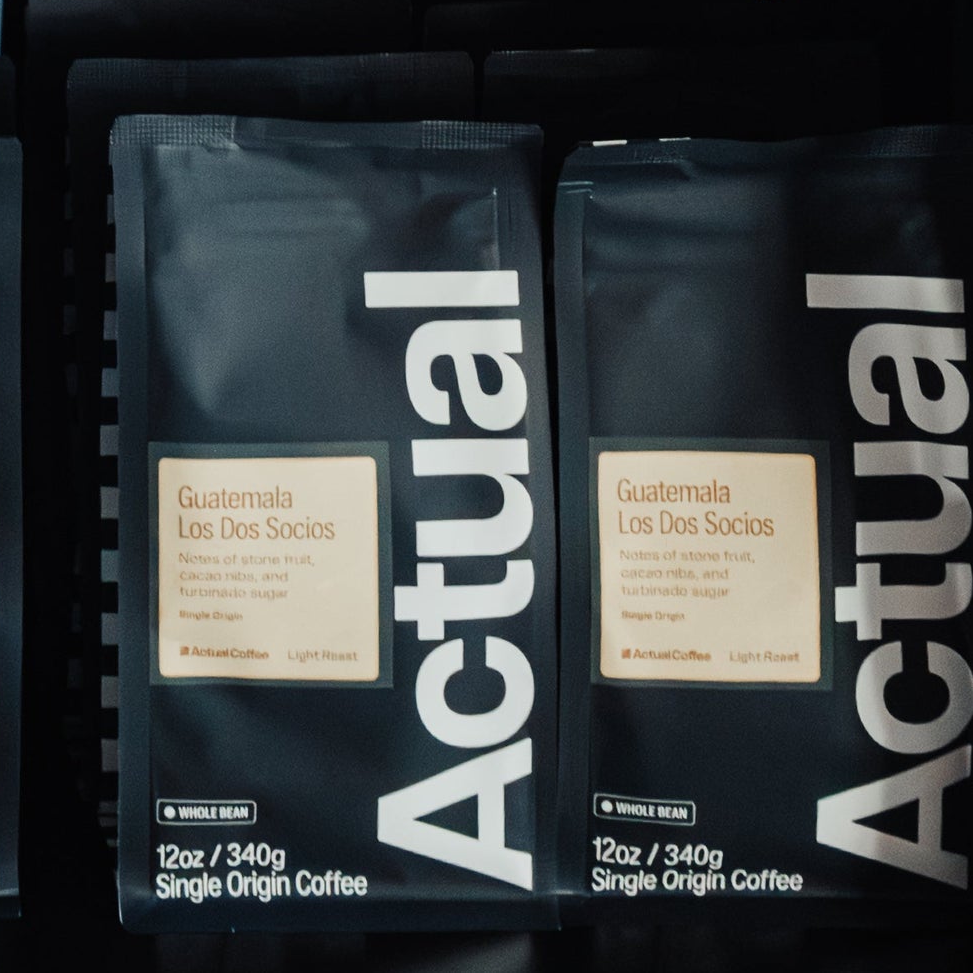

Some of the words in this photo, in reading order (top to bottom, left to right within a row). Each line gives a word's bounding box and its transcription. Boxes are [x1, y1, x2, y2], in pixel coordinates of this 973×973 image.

[177, 484, 293, 510] Guatemala
[617, 478, 731, 504] Guatemala
[177, 515, 214, 540] Los
[220, 516, 260, 540] Dos
[265, 515, 335, 540] Socios
[618, 510, 653, 535] Los
[659, 509, 699, 535] Dos
[704, 510, 775, 537] Socios
[619, 549, 660, 562] Notes
[662, 549, 677, 561] of
[680, 550, 721, 562] stone
[364, 270, 535, 891] Actual
[620, 569, 663, 579] cacao
[701, 567, 729, 580] and
[806, 274, 973, 890] Actual
[691, 586, 730, 600] sugar
[177, 805, 217, 820] WHOLE
[218, 805, 249, 819] BEAN
[615, 801, 655, 817] WHOLE
[656, 805, 688, 819] BEAN
[156, 843, 205, 870] 12oz
[226, 843, 286, 873] 340g
[591, 836, 642, 866] 12oz
[663, 843, 724, 871] 340g
[155, 871, 222, 902] Single
[226, 870, 291, 901] Origin
[294, 870, 368, 897] Coffee
[591, 868, 658, 895] Single
[661, 868, 726, 894] Origin
[730, 868, 803, 892] Coffee
